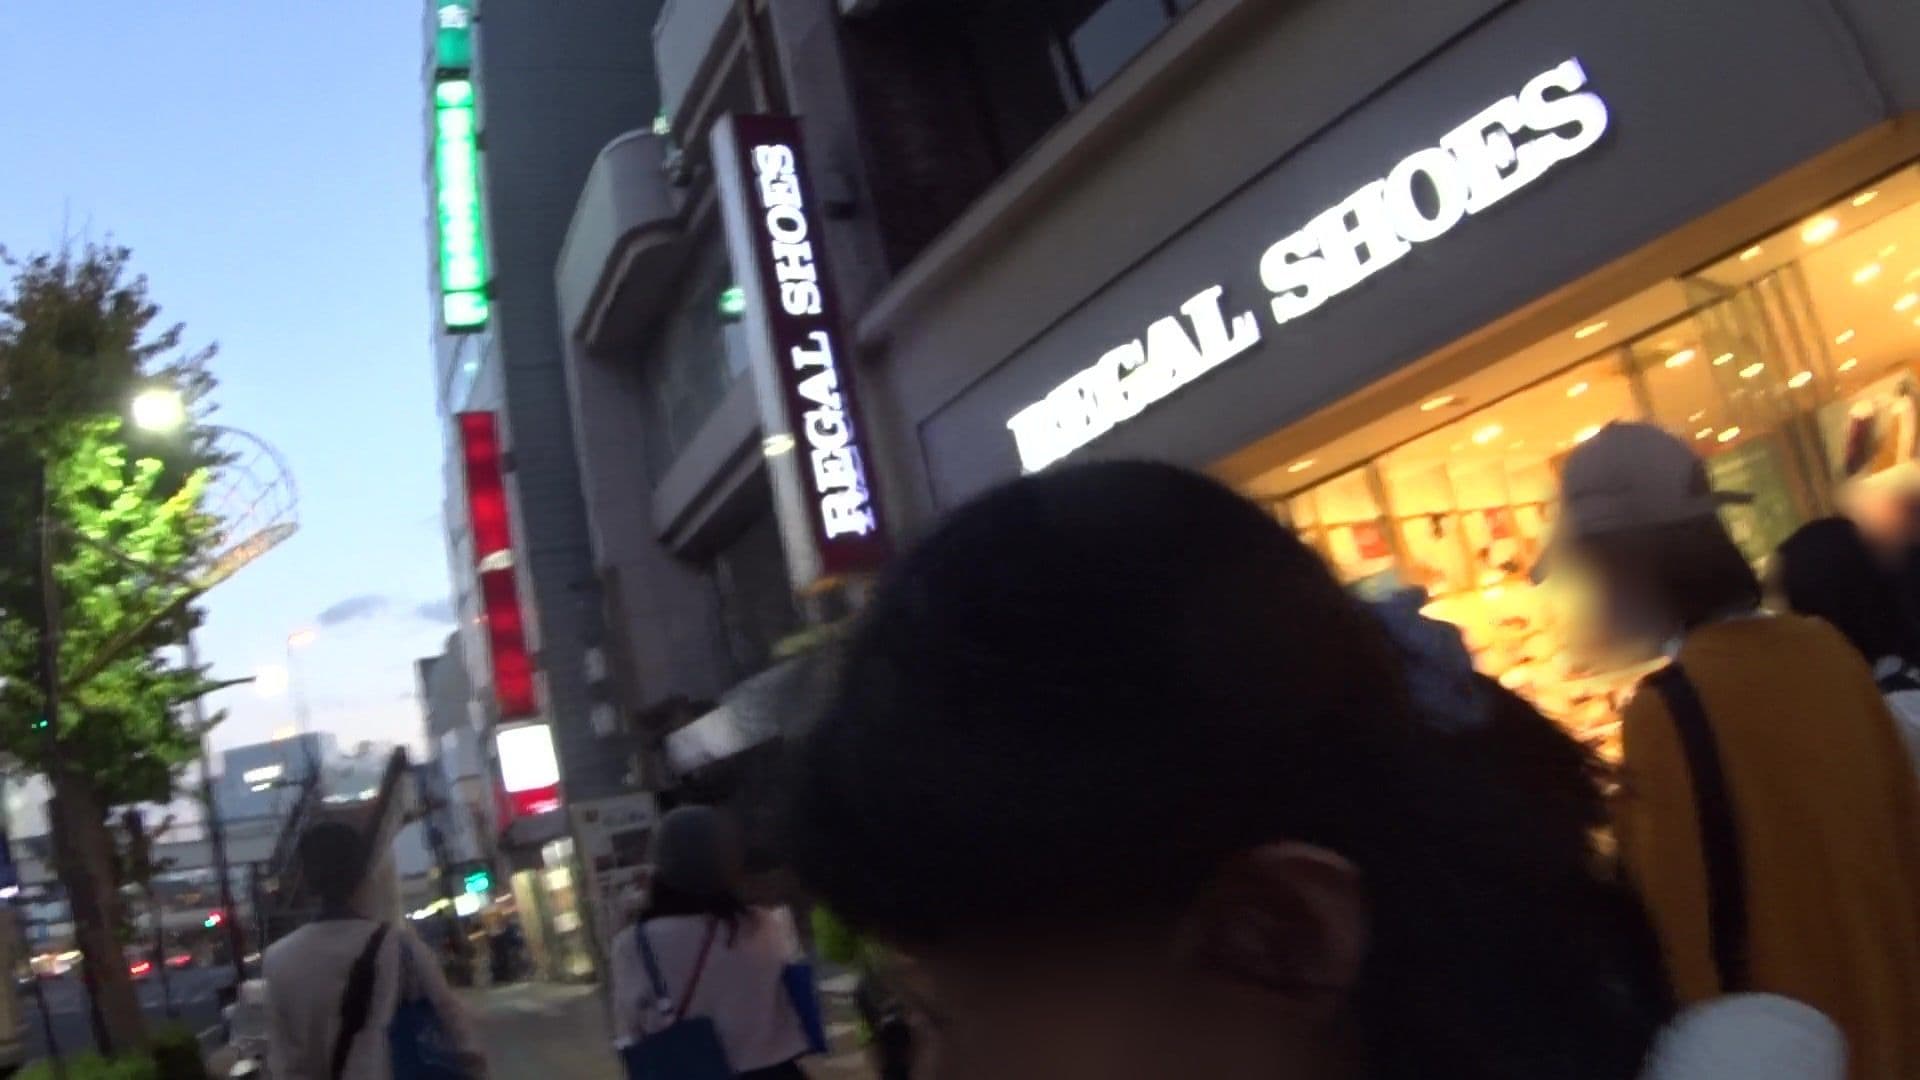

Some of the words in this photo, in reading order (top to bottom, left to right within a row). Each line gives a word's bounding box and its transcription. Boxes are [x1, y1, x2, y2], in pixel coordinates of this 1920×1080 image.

[751, 143, 823, 317] SHOES
[1006, 284, 1261, 476] REGAL
[1259, 57, 1608, 325] SHOES
[791, 330, 877, 541] REGAL
